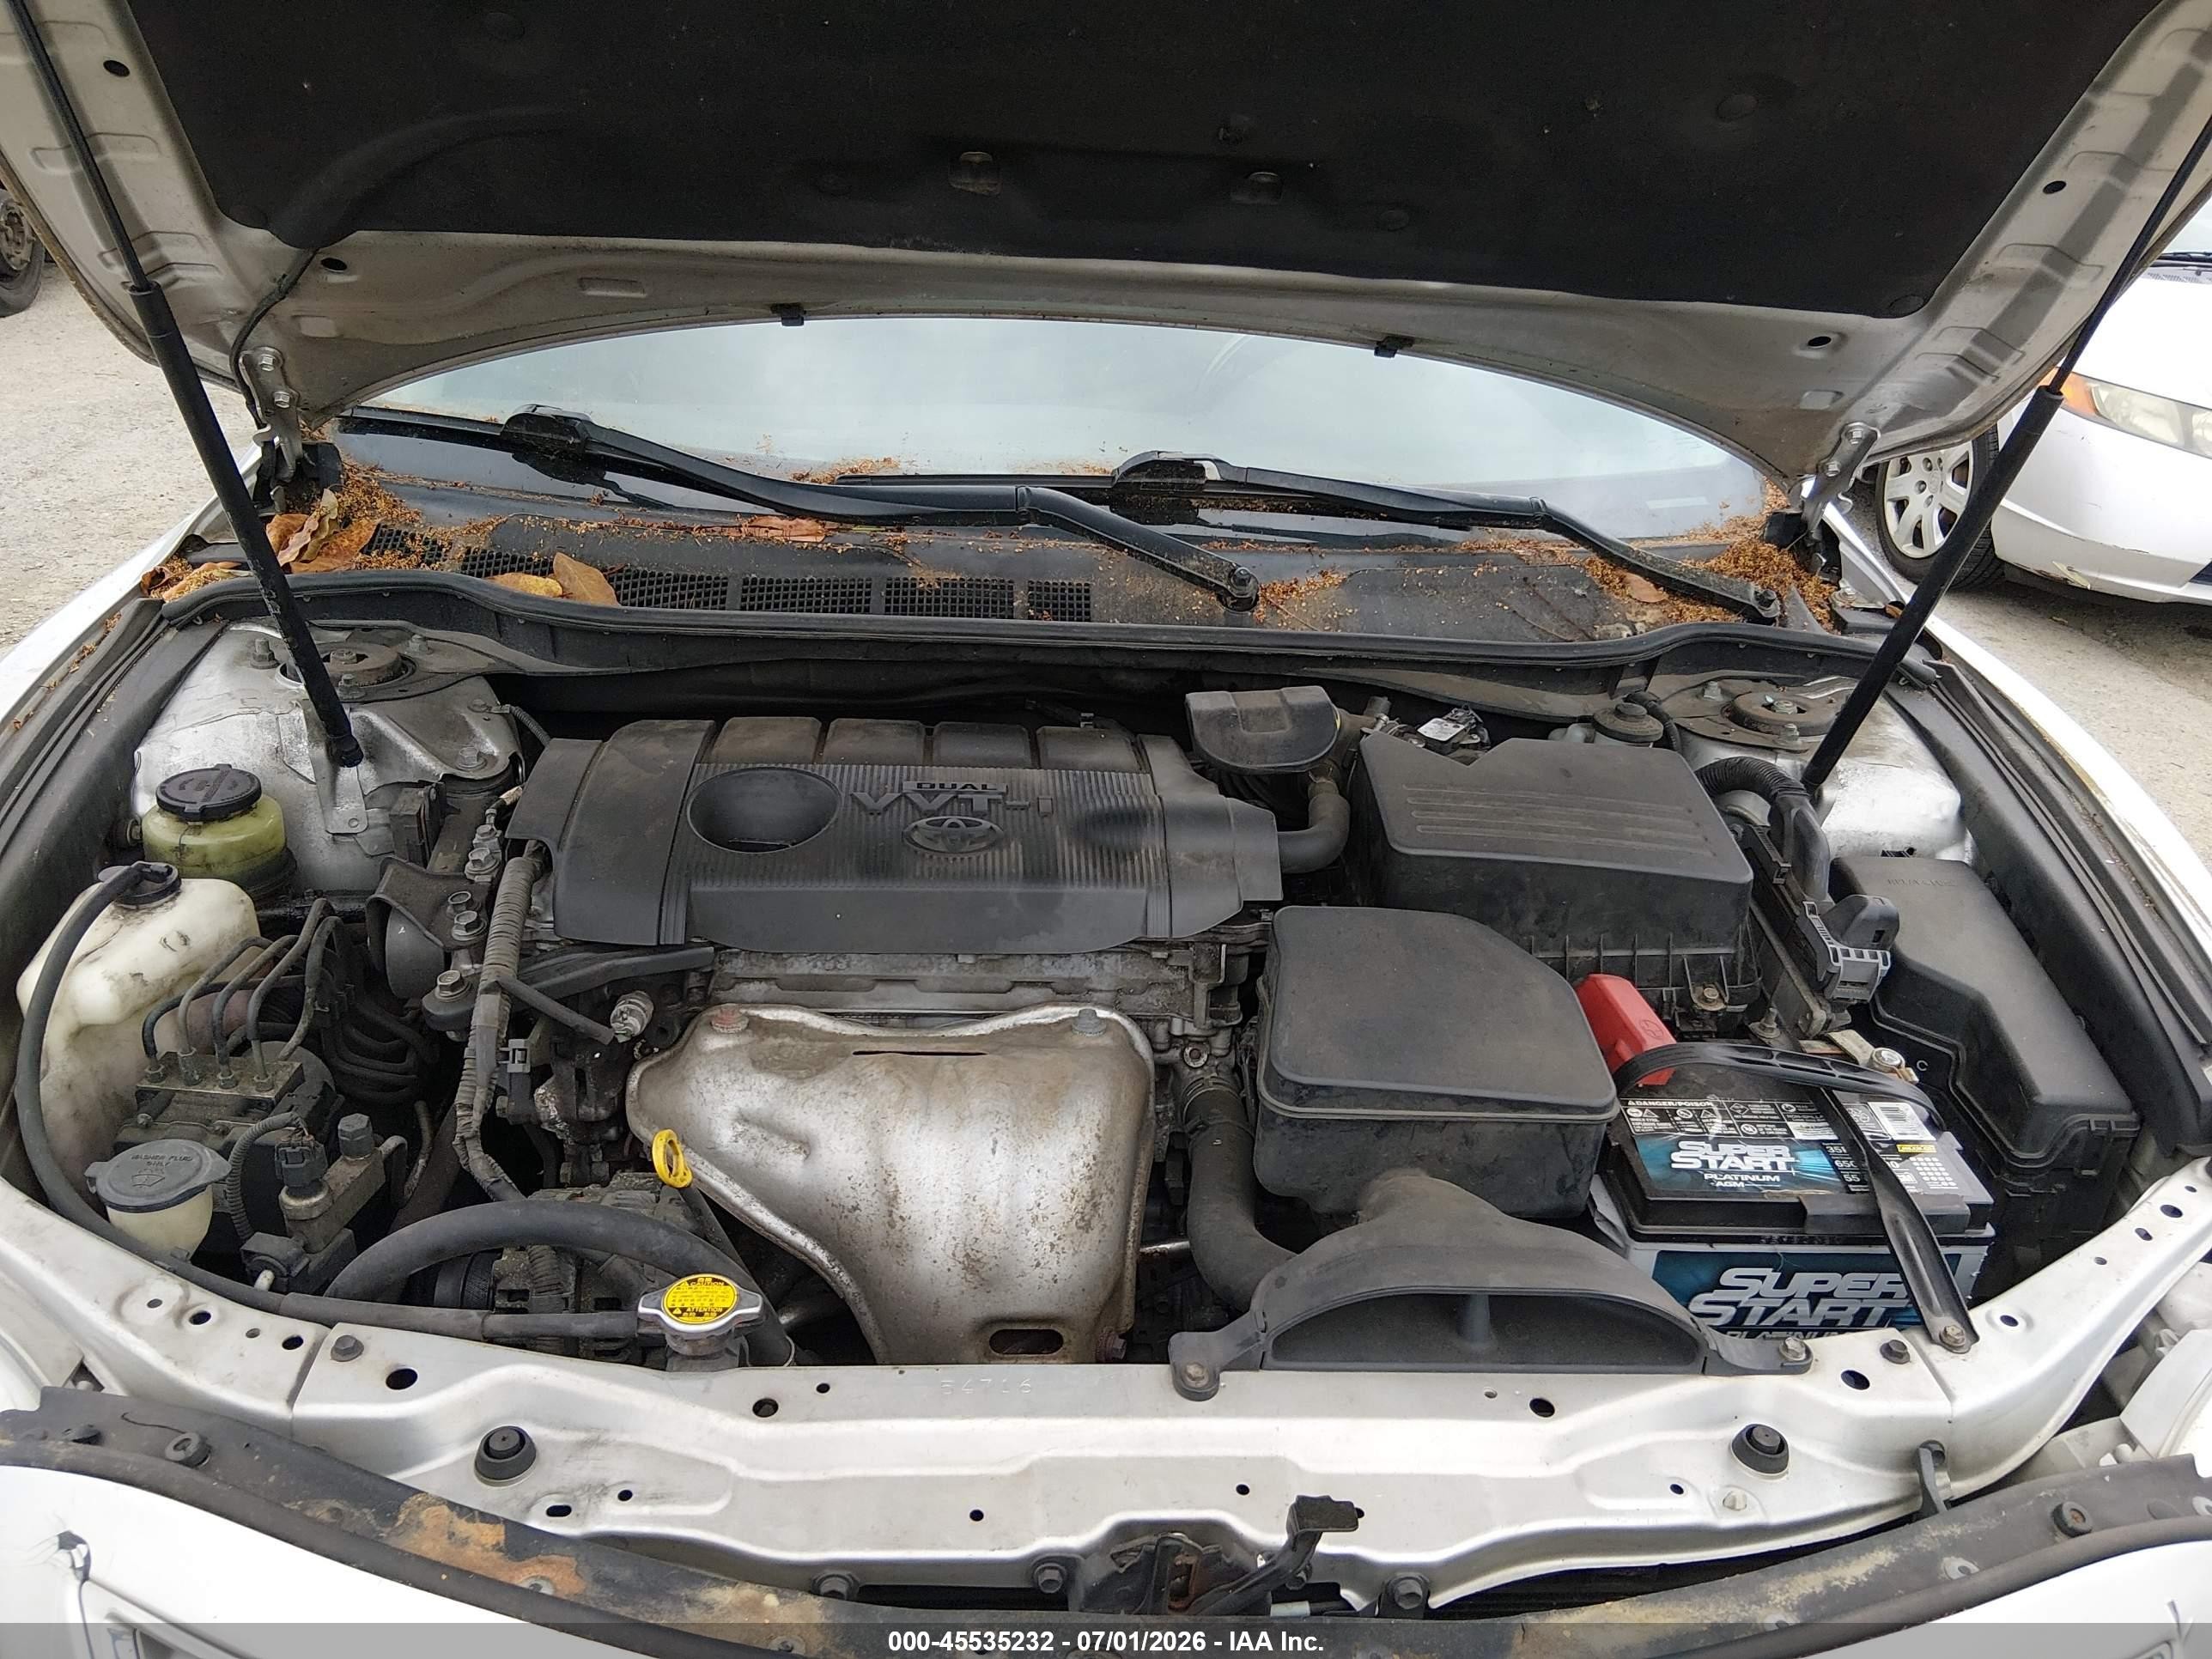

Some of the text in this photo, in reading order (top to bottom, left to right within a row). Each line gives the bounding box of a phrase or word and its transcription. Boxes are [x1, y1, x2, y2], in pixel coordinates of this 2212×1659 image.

[1677, 1140, 1790, 1158] SUPER
[1670, 1152, 1796, 1171] START
[1704, 1173, 1781, 1182] PLATINUM
[1687, 1291, 1911, 1327] START
